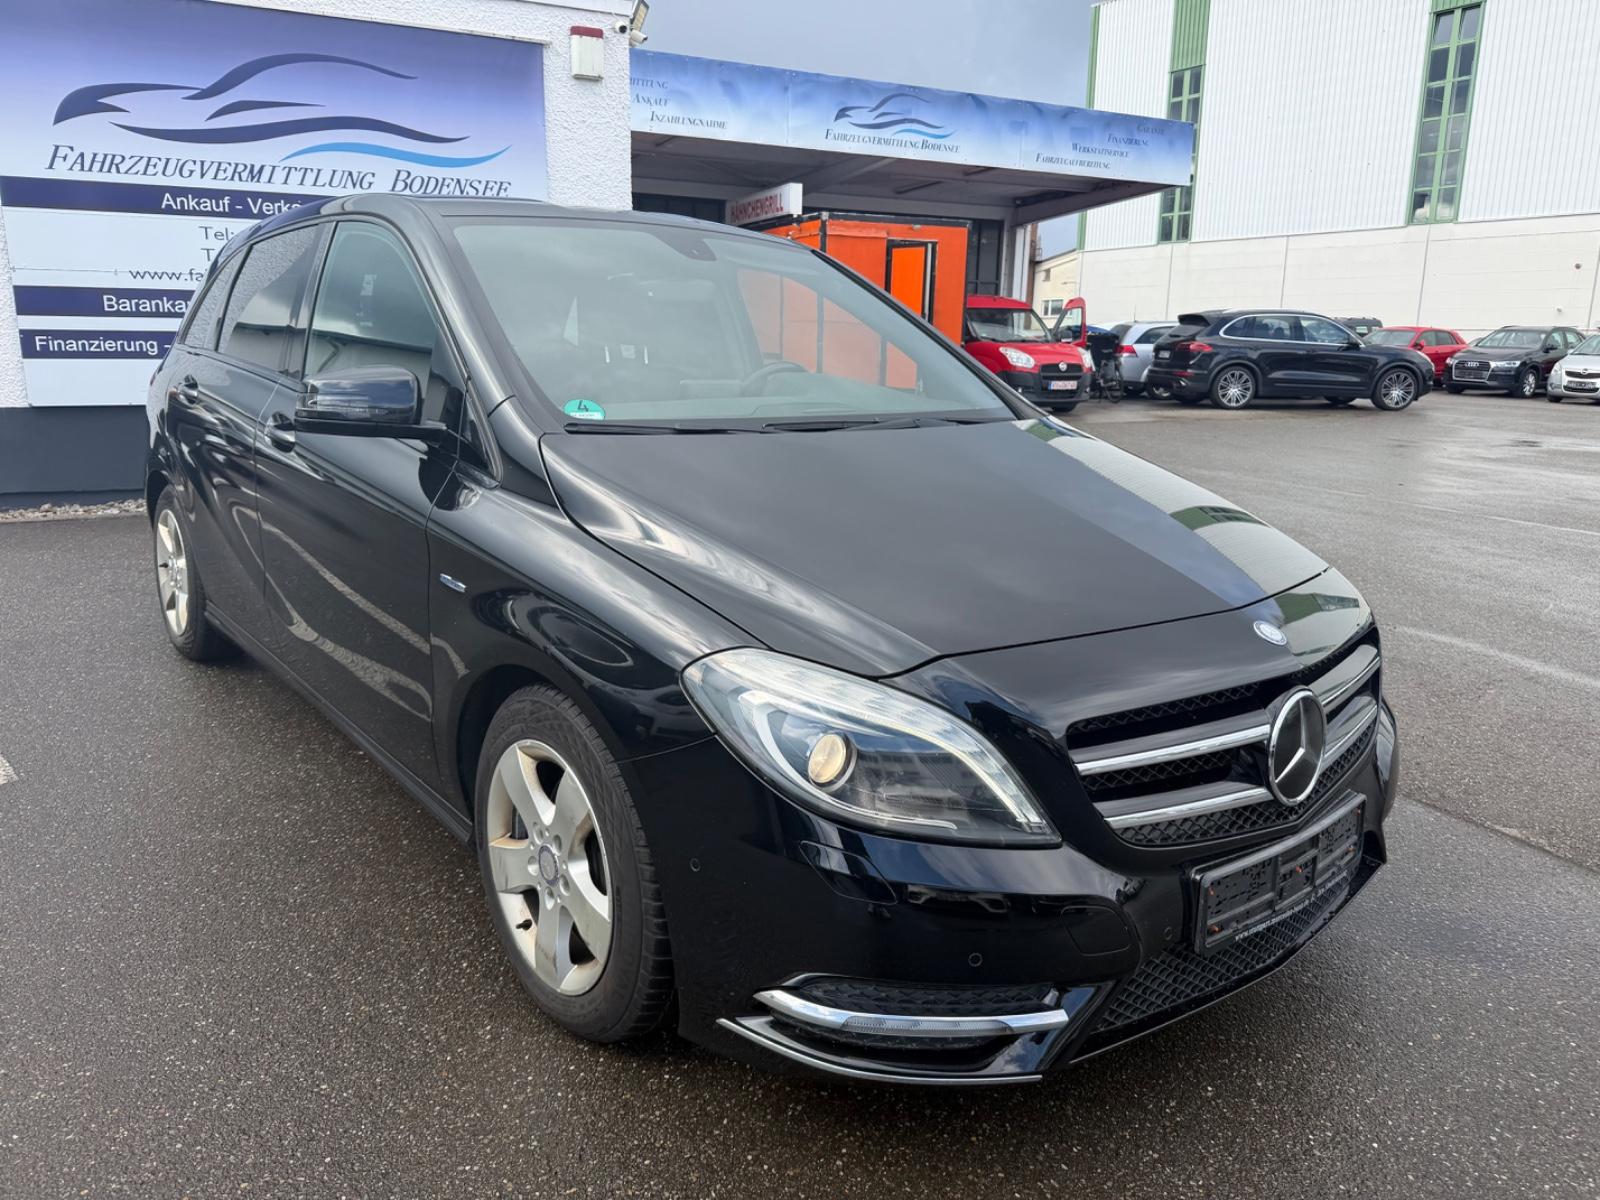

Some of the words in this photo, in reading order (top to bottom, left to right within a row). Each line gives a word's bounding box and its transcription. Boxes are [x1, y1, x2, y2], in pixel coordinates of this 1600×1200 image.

[824, 128, 920, 150] FAHRZEUGVERMITTLUNG
[920, 138, 962, 154] BODENSEE
[44, 143, 376, 190] FAHRZEUGVERMITTLUNG
[390, 168, 512, 197] BODENSEE
[160, 191, 231, 214] Ankauf
[128, 267, 208, 282] www.fa
[101, 294, 191, 314] Baranka
[34, 335, 158, 356] Finanzierung
[576, 399, 590, 412] 4
